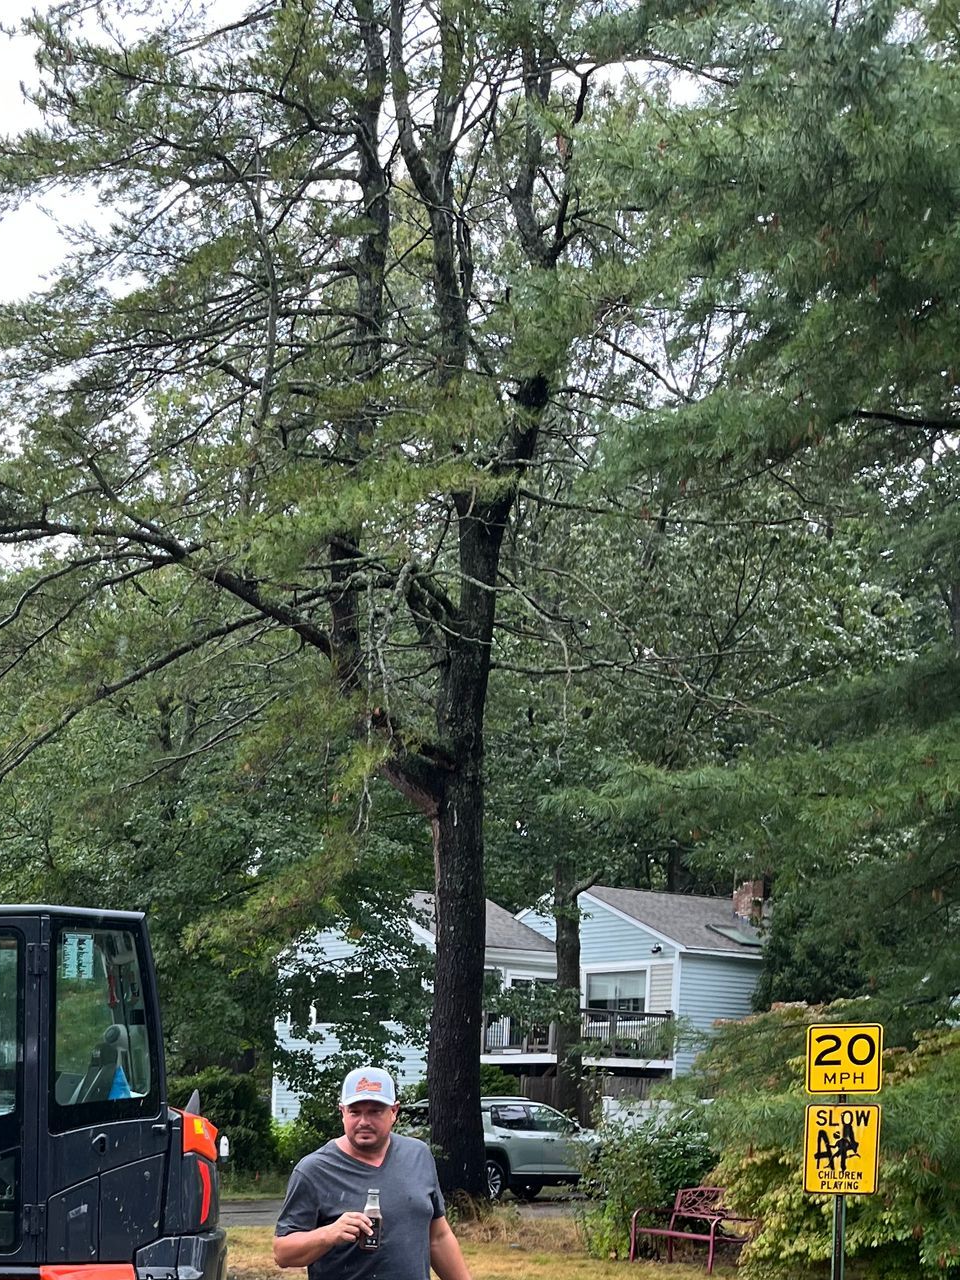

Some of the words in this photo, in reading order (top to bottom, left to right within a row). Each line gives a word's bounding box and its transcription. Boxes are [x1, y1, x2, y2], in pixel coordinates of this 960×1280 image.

[814, 1033, 876, 1066] 20
[823, 1072, 865, 1084] MPH
[815, 1109, 871, 1127] SLOW
[818, 1170, 863, 1180] CHILDREN
[820, 1180, 859, 1190] PLAYING
